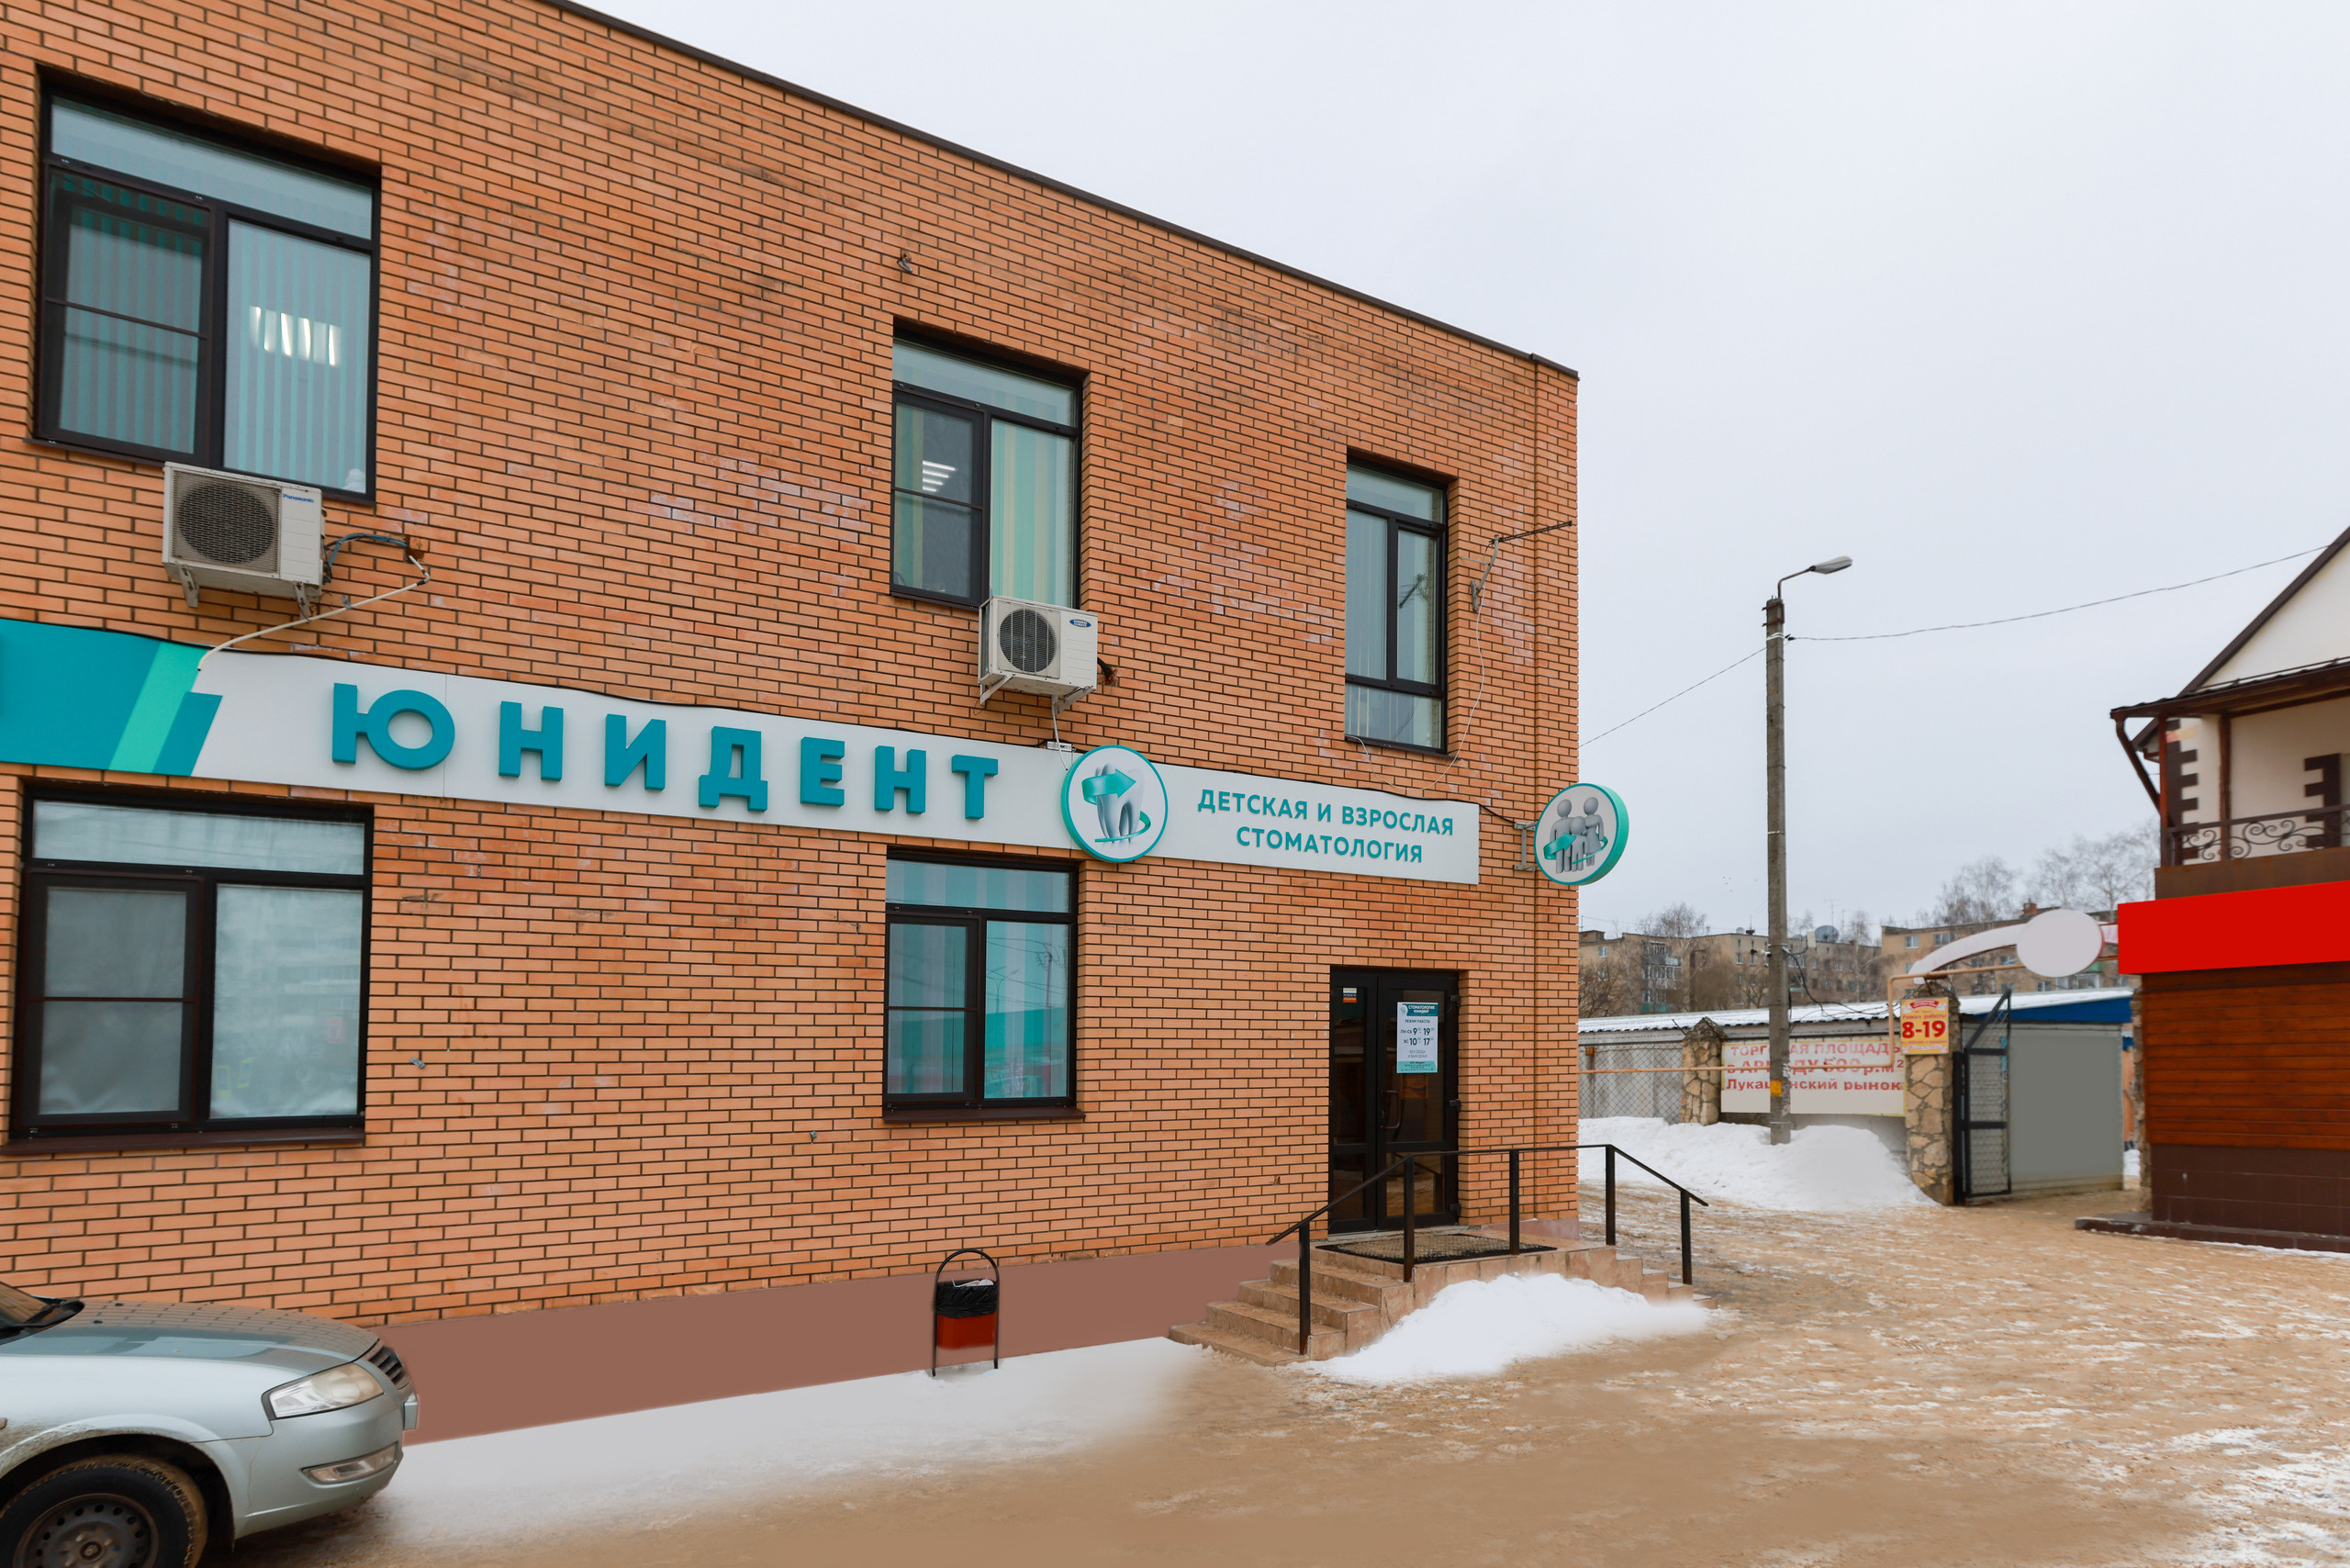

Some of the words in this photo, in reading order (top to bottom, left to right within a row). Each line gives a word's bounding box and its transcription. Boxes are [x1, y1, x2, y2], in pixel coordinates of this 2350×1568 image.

[283, 493, 314, 503] Panasonic
[332, 682, 998, 820] ЮНИДЕНТ
[1197, 789, 1308, 820] ДЕТСКАЯ
[1317, 802, 1332, 823] И
[1342, 805, 1454, 836] ВЗРОСЛАЯ
[1237, 826, 1423, 864] СТОМАТОЛОГИЯ
[1902, 1020, 1946, 1039] 8-19
[1730, 1044, 1809, 1057] ТОРГАЯ
[1727, 1079, 1838, 1091] Луканский
[1844, 1081, 1903, 1091] рынок
